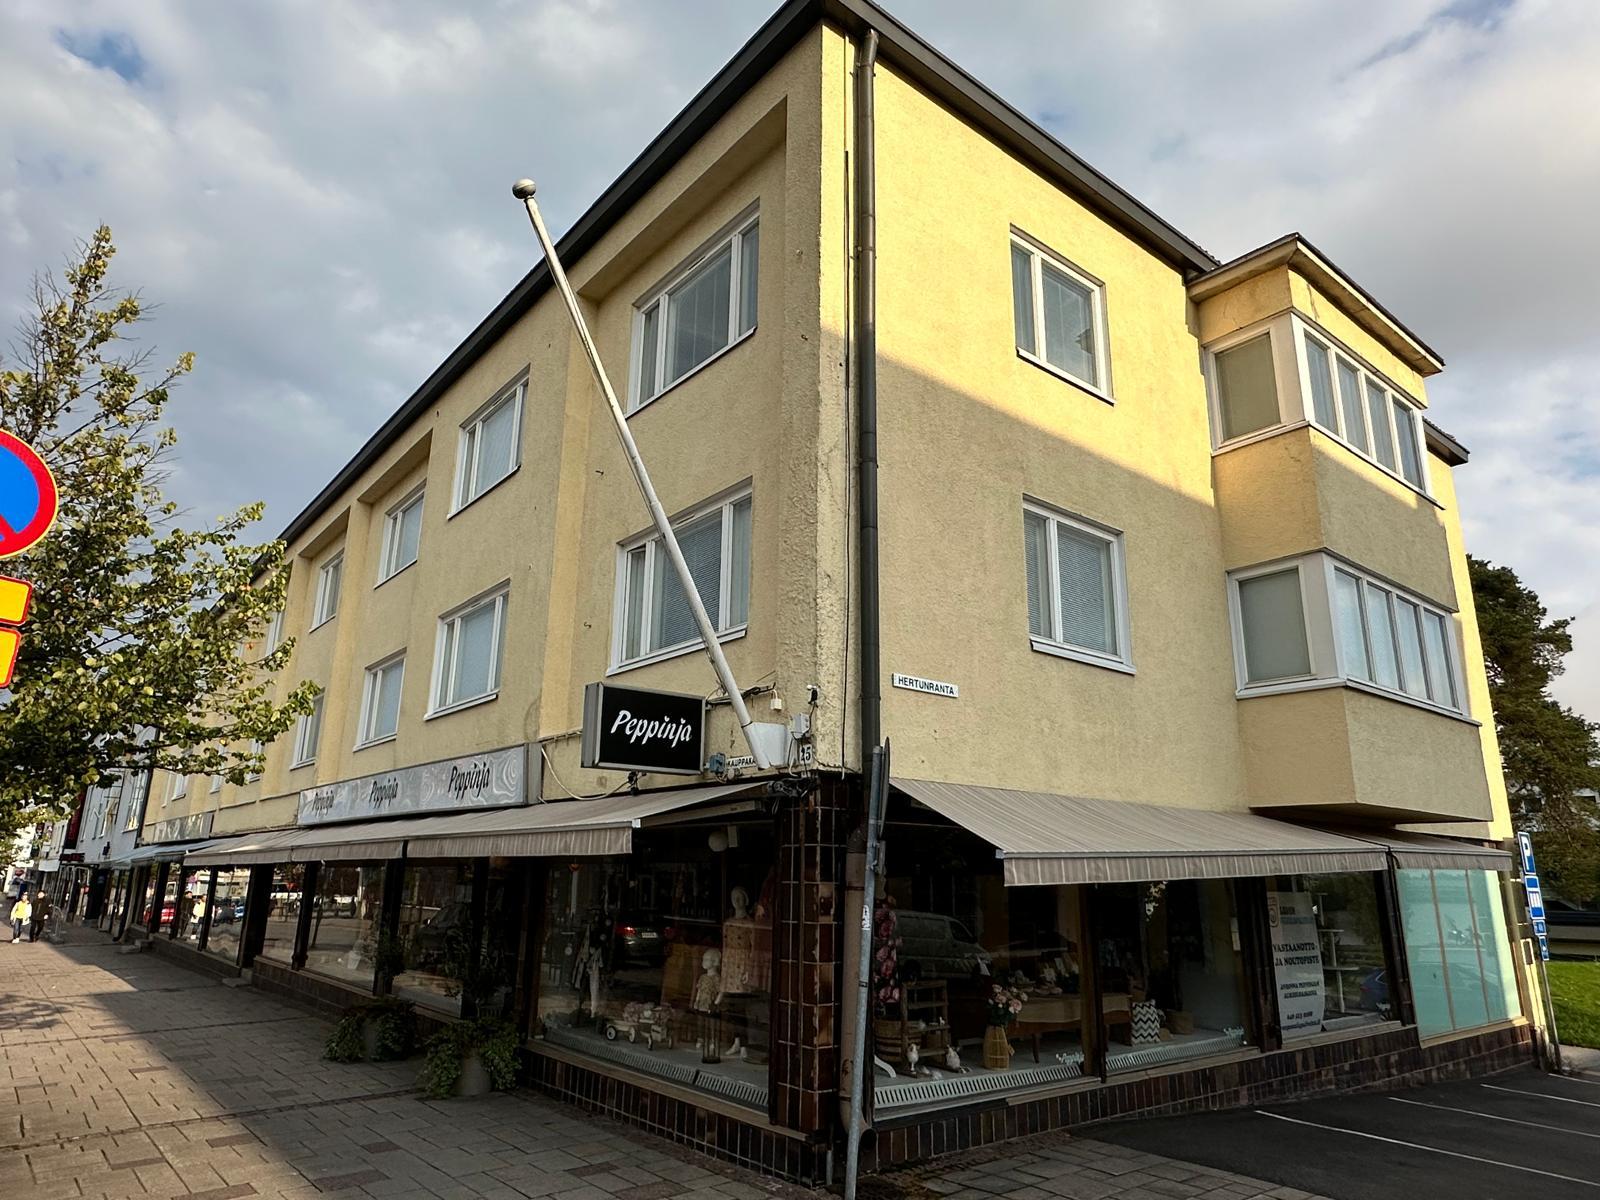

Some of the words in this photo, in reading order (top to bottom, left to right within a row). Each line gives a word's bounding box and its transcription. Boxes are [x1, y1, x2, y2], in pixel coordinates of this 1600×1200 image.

[898, 676, 955, 695] HERTUNRANTA
[610, 710, 692, 748] Peppinja
[448, 761, 490, 800] Peppinja
[1520, 836, 1531, 870] P
[1275, 957, 1284, 966] JA
